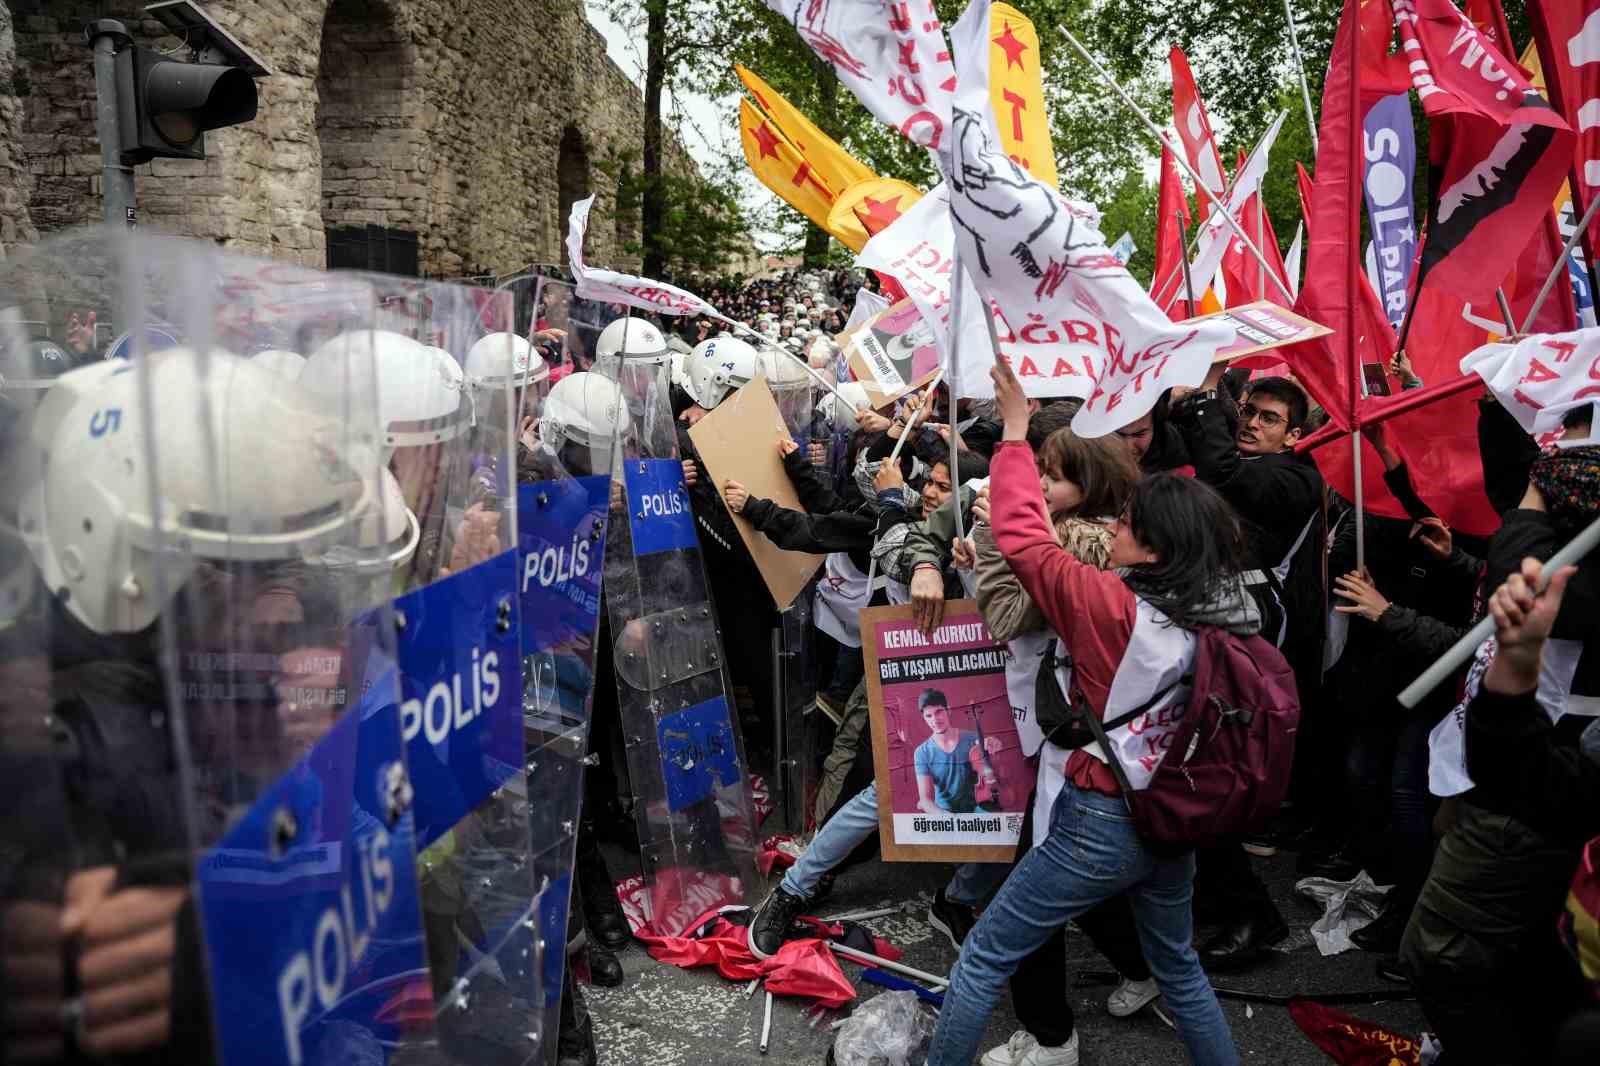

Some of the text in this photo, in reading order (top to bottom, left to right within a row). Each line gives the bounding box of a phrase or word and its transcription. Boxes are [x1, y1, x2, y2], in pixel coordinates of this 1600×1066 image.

[89, 407, 121, 438] 5
[642, 489, 682, 517] POLİS
[523, 533, 590, 592] POLİS
[932, 623, 984, 645] KURKUT
[880, 659, 900, 679] BİR
[902, 657, 945, 680] YAŞAM
[402, 648, 500, 743] POLİS
[913, 818, 1001, 833] öğrenci faaliyeti
[278, 829, 394, 1065] POLİS
